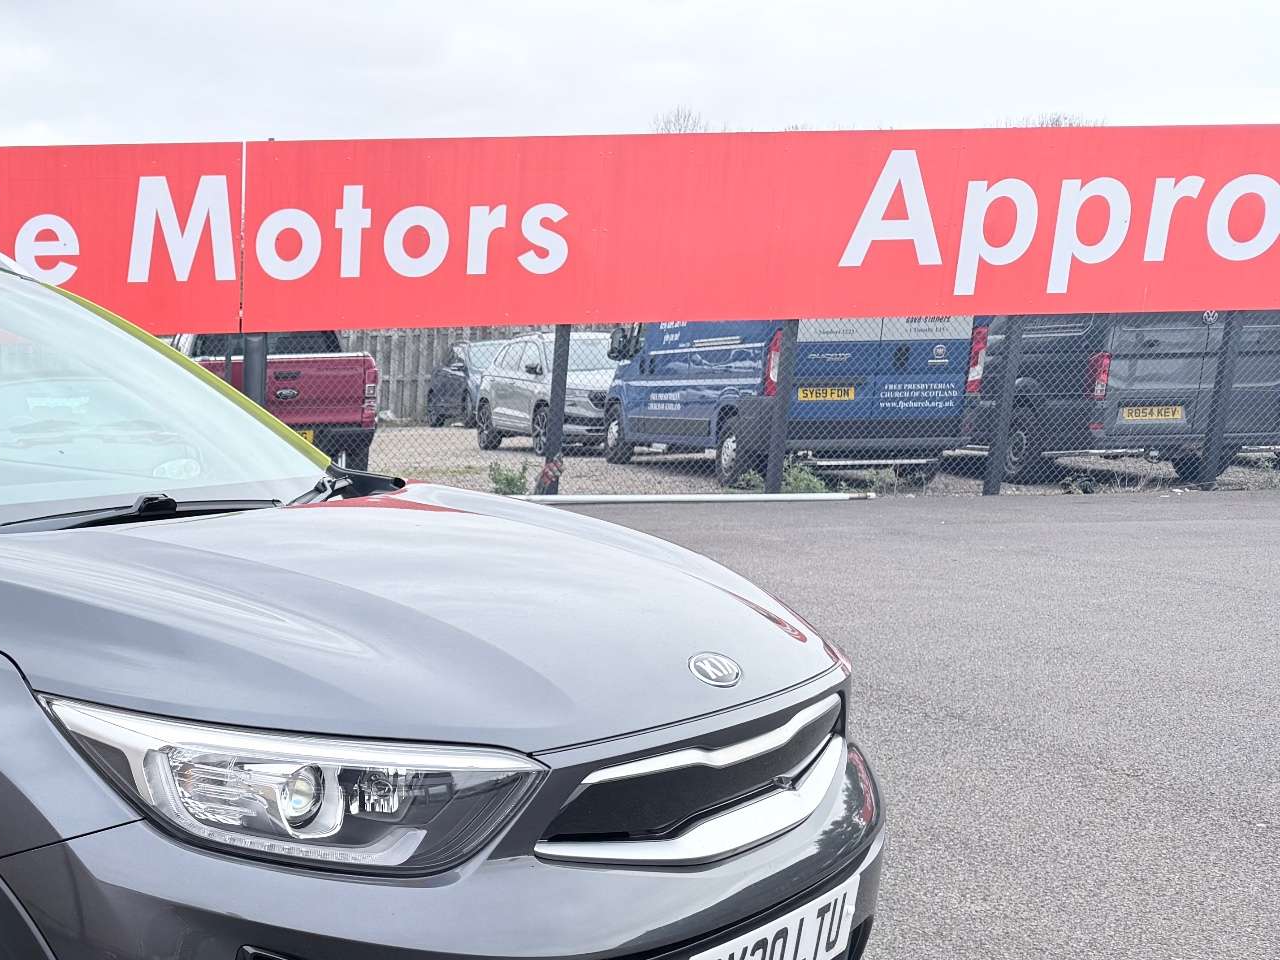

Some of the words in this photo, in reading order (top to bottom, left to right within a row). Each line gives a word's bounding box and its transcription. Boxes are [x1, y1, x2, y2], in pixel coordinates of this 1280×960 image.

[127, 174, 569, 282] Motors
[838, 149, 1280, 296] Appro
[1157, 407, 1178, 418] KEV
